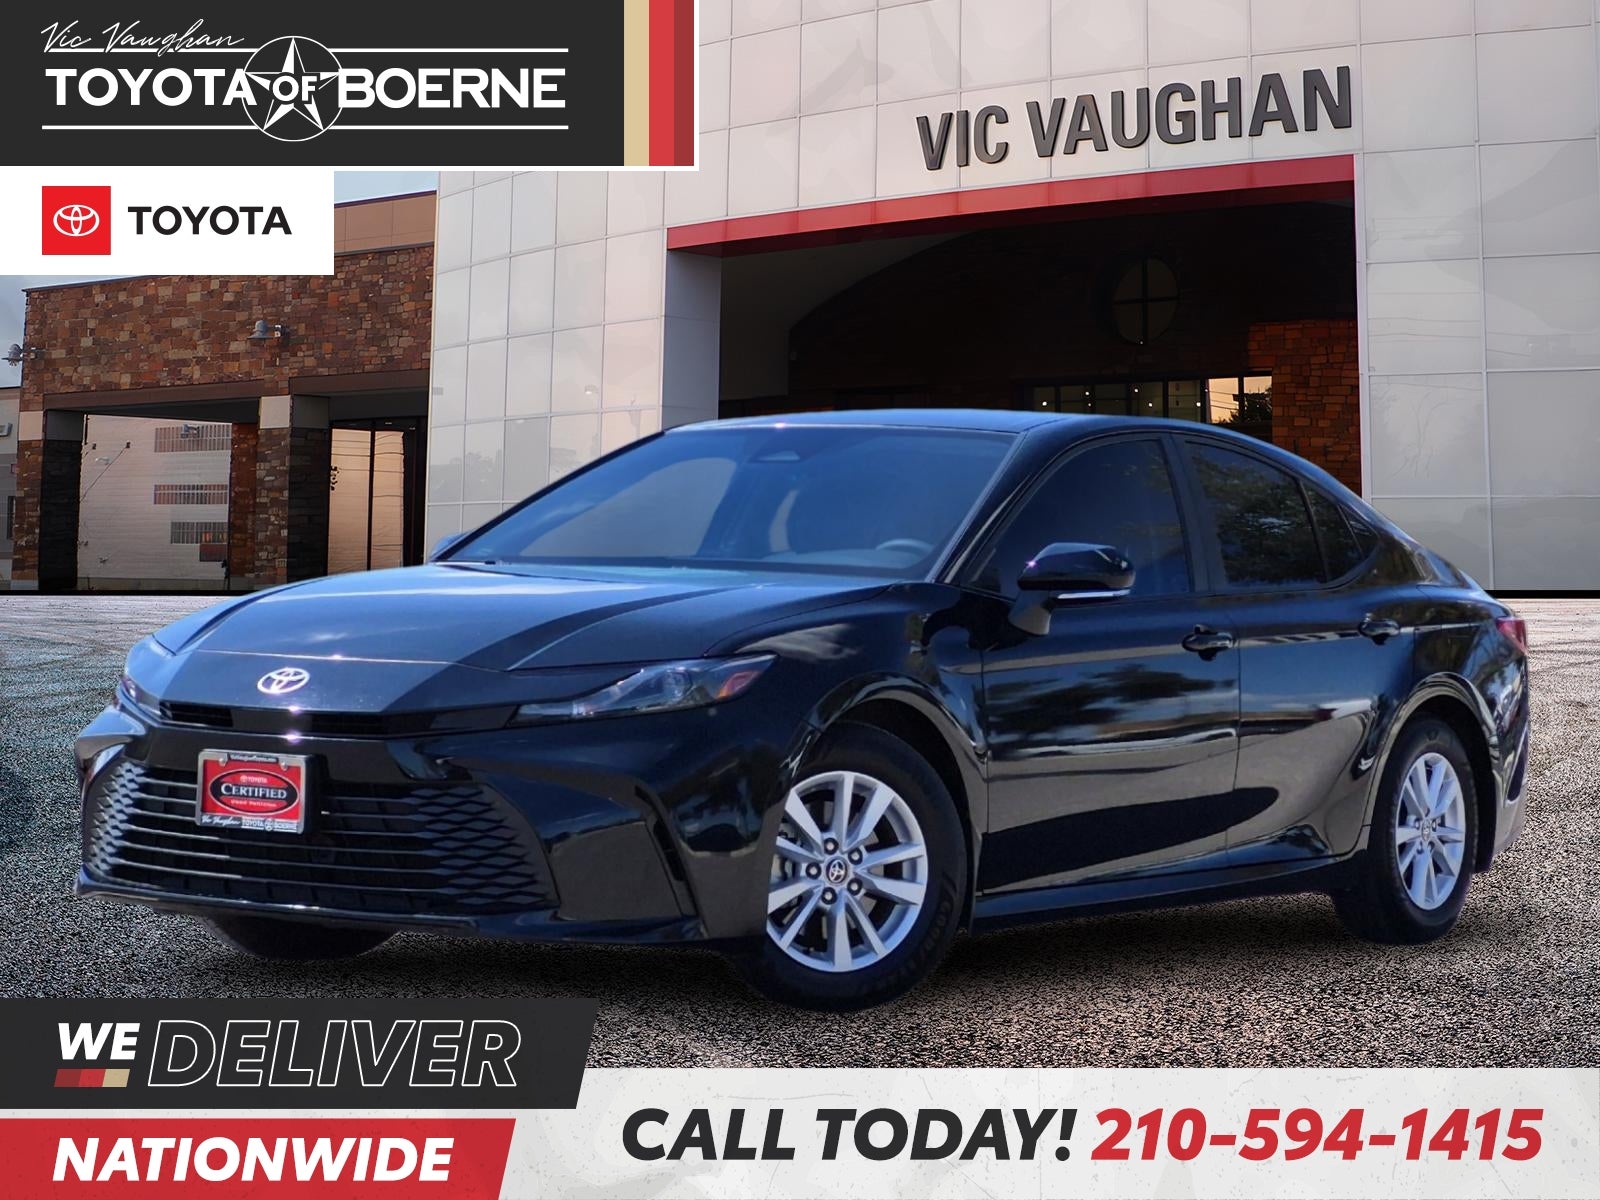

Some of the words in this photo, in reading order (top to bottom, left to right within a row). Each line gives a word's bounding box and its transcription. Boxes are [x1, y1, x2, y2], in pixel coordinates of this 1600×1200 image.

[915, 104, 1010, 171] VIC
[1025, 65, 1353, 159] VAUGHAN
[221, 783, 287, 799] CERTIFIED
